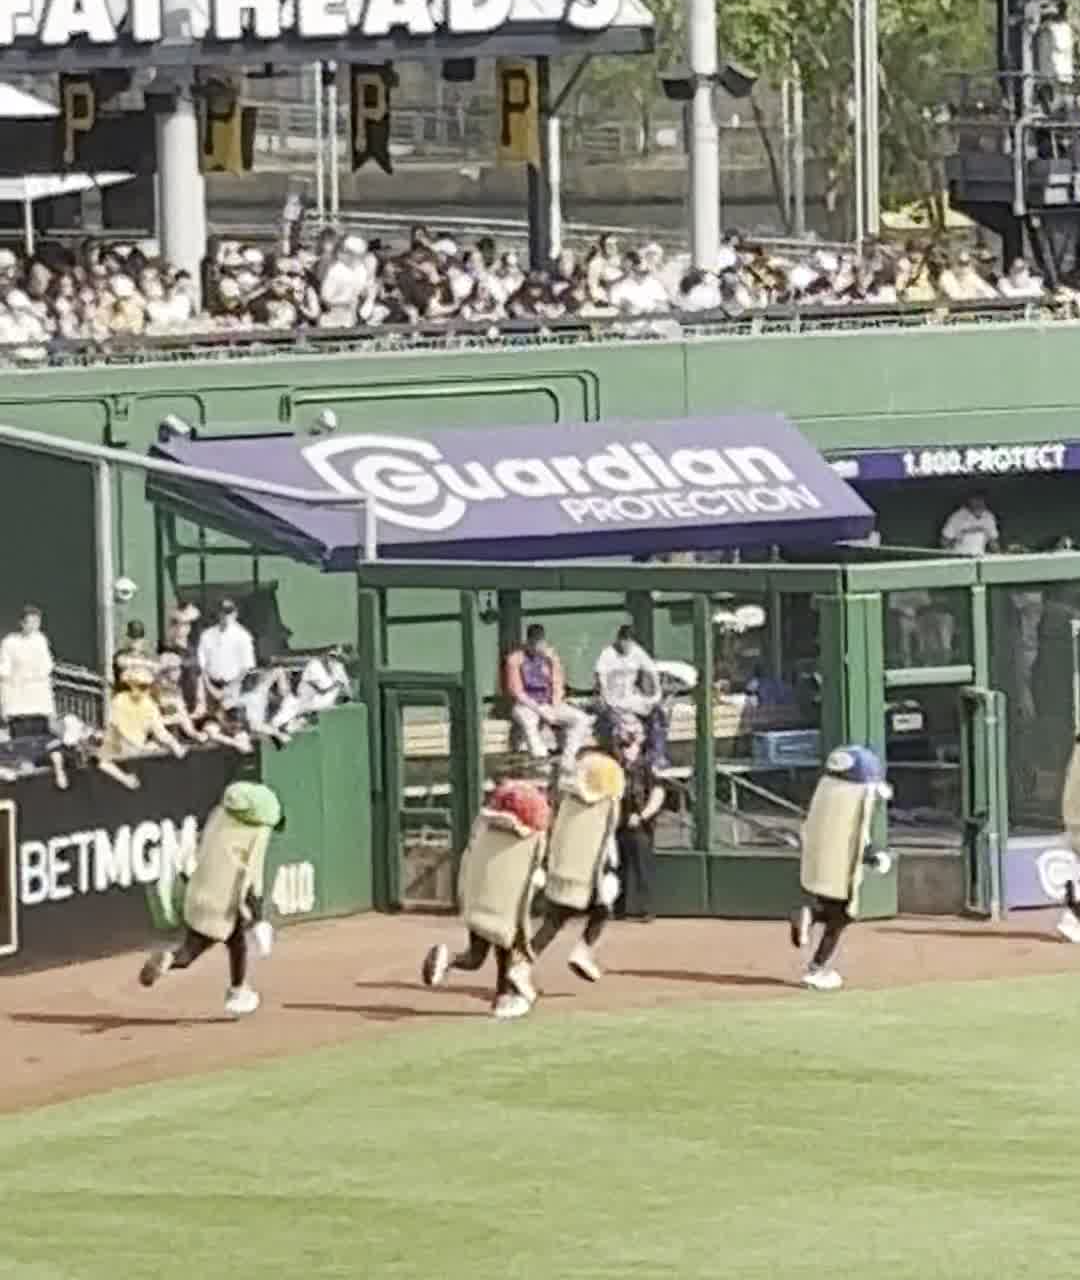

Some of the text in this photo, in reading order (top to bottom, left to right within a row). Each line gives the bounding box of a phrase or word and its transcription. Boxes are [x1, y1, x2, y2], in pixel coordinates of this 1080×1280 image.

[63, 81, 95, 164] P
[356, 73, 386, 153] P
[502, 70, 530, 147] P
[325, 437, 796, 517] Guardian
[560, 483, 822, 525] PROTECTION
[19, 815, 199, 905] BETMGM
